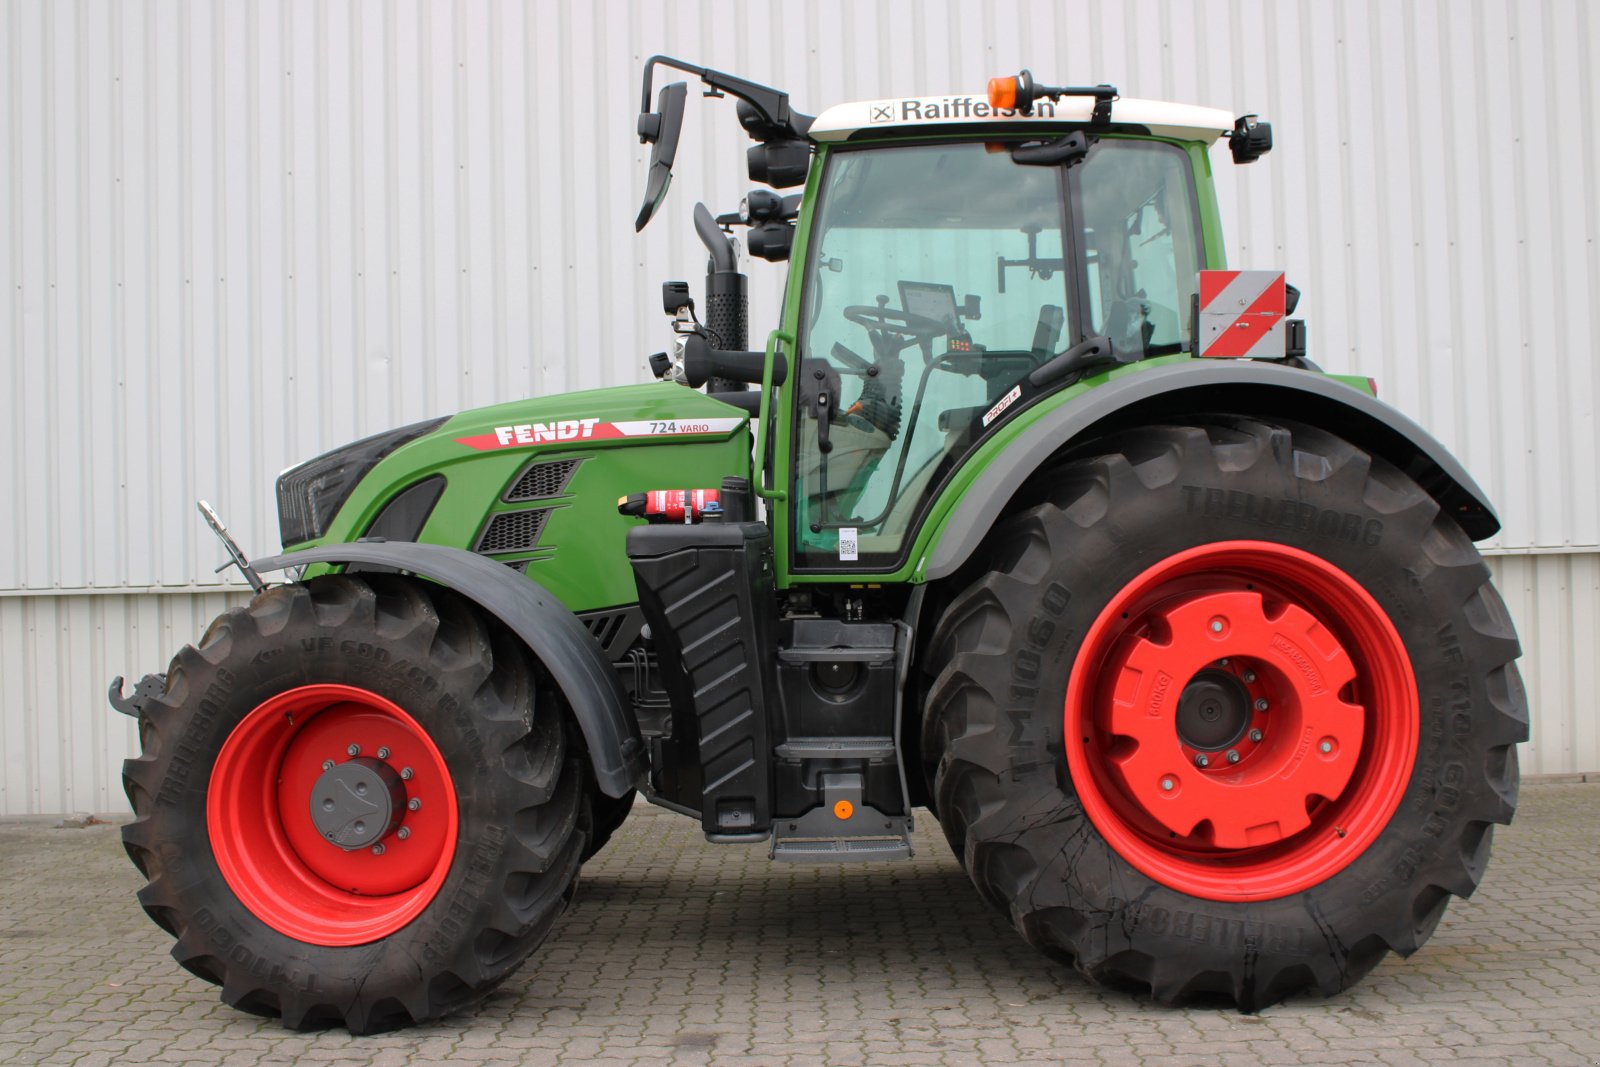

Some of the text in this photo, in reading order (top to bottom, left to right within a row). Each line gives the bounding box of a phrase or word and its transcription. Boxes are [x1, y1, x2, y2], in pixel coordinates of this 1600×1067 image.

[494, 418, 709, 446] FENDT 724 VARIO
[1181, 485, 1385, 548] TRELLEBORG
[1006, 582, 1073, 783] TM1060
[155, 667, 236, 809] TRELLEBORG
